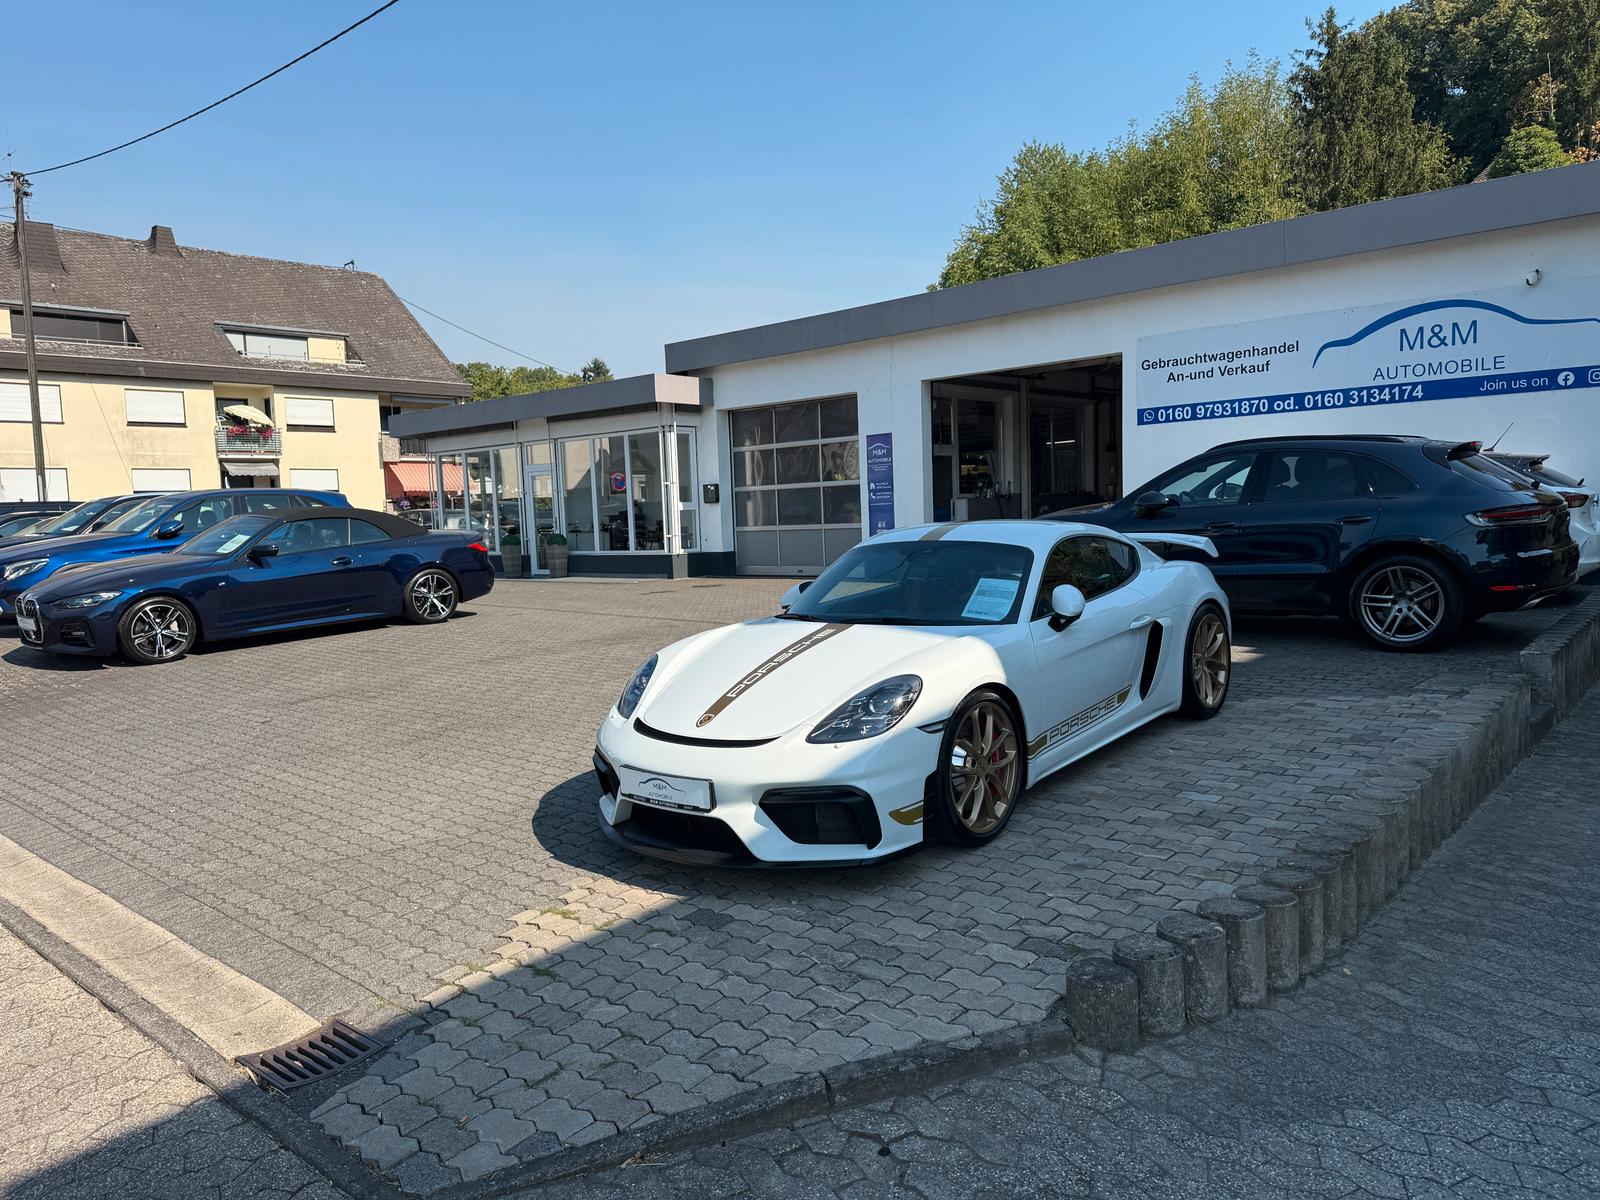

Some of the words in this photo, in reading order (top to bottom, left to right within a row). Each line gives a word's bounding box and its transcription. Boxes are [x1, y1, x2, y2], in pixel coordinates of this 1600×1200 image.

[1399, 319, 1478, 352] M&M
[1141, 340, 1300, 371] Gebrauchtwagenhandel
[1372, 355, 1506, 382] AUTOMOBILE
[1166, 367, 1214, 383] An-und
[1218, 360, 1271, 377] Verkauf
[1480, 379, 1507, 392] Join
[1511, 378, 1527, 389] us
[1531, 377, 1549, 387] on
[1157, 406, 1192, 422] 0160
[1196, 399, 1269, 418] 97931870
[1273, 396, 1299, 411] od.
[1304, 392, 1344, 408] 0160
[1349, 384, 1424, 405] 3134174
[726, 628, 837, 698] PORSCHE
[1049, 696, 1116, 743] PORSCHE
[652, 783, 667, 791] M&M
